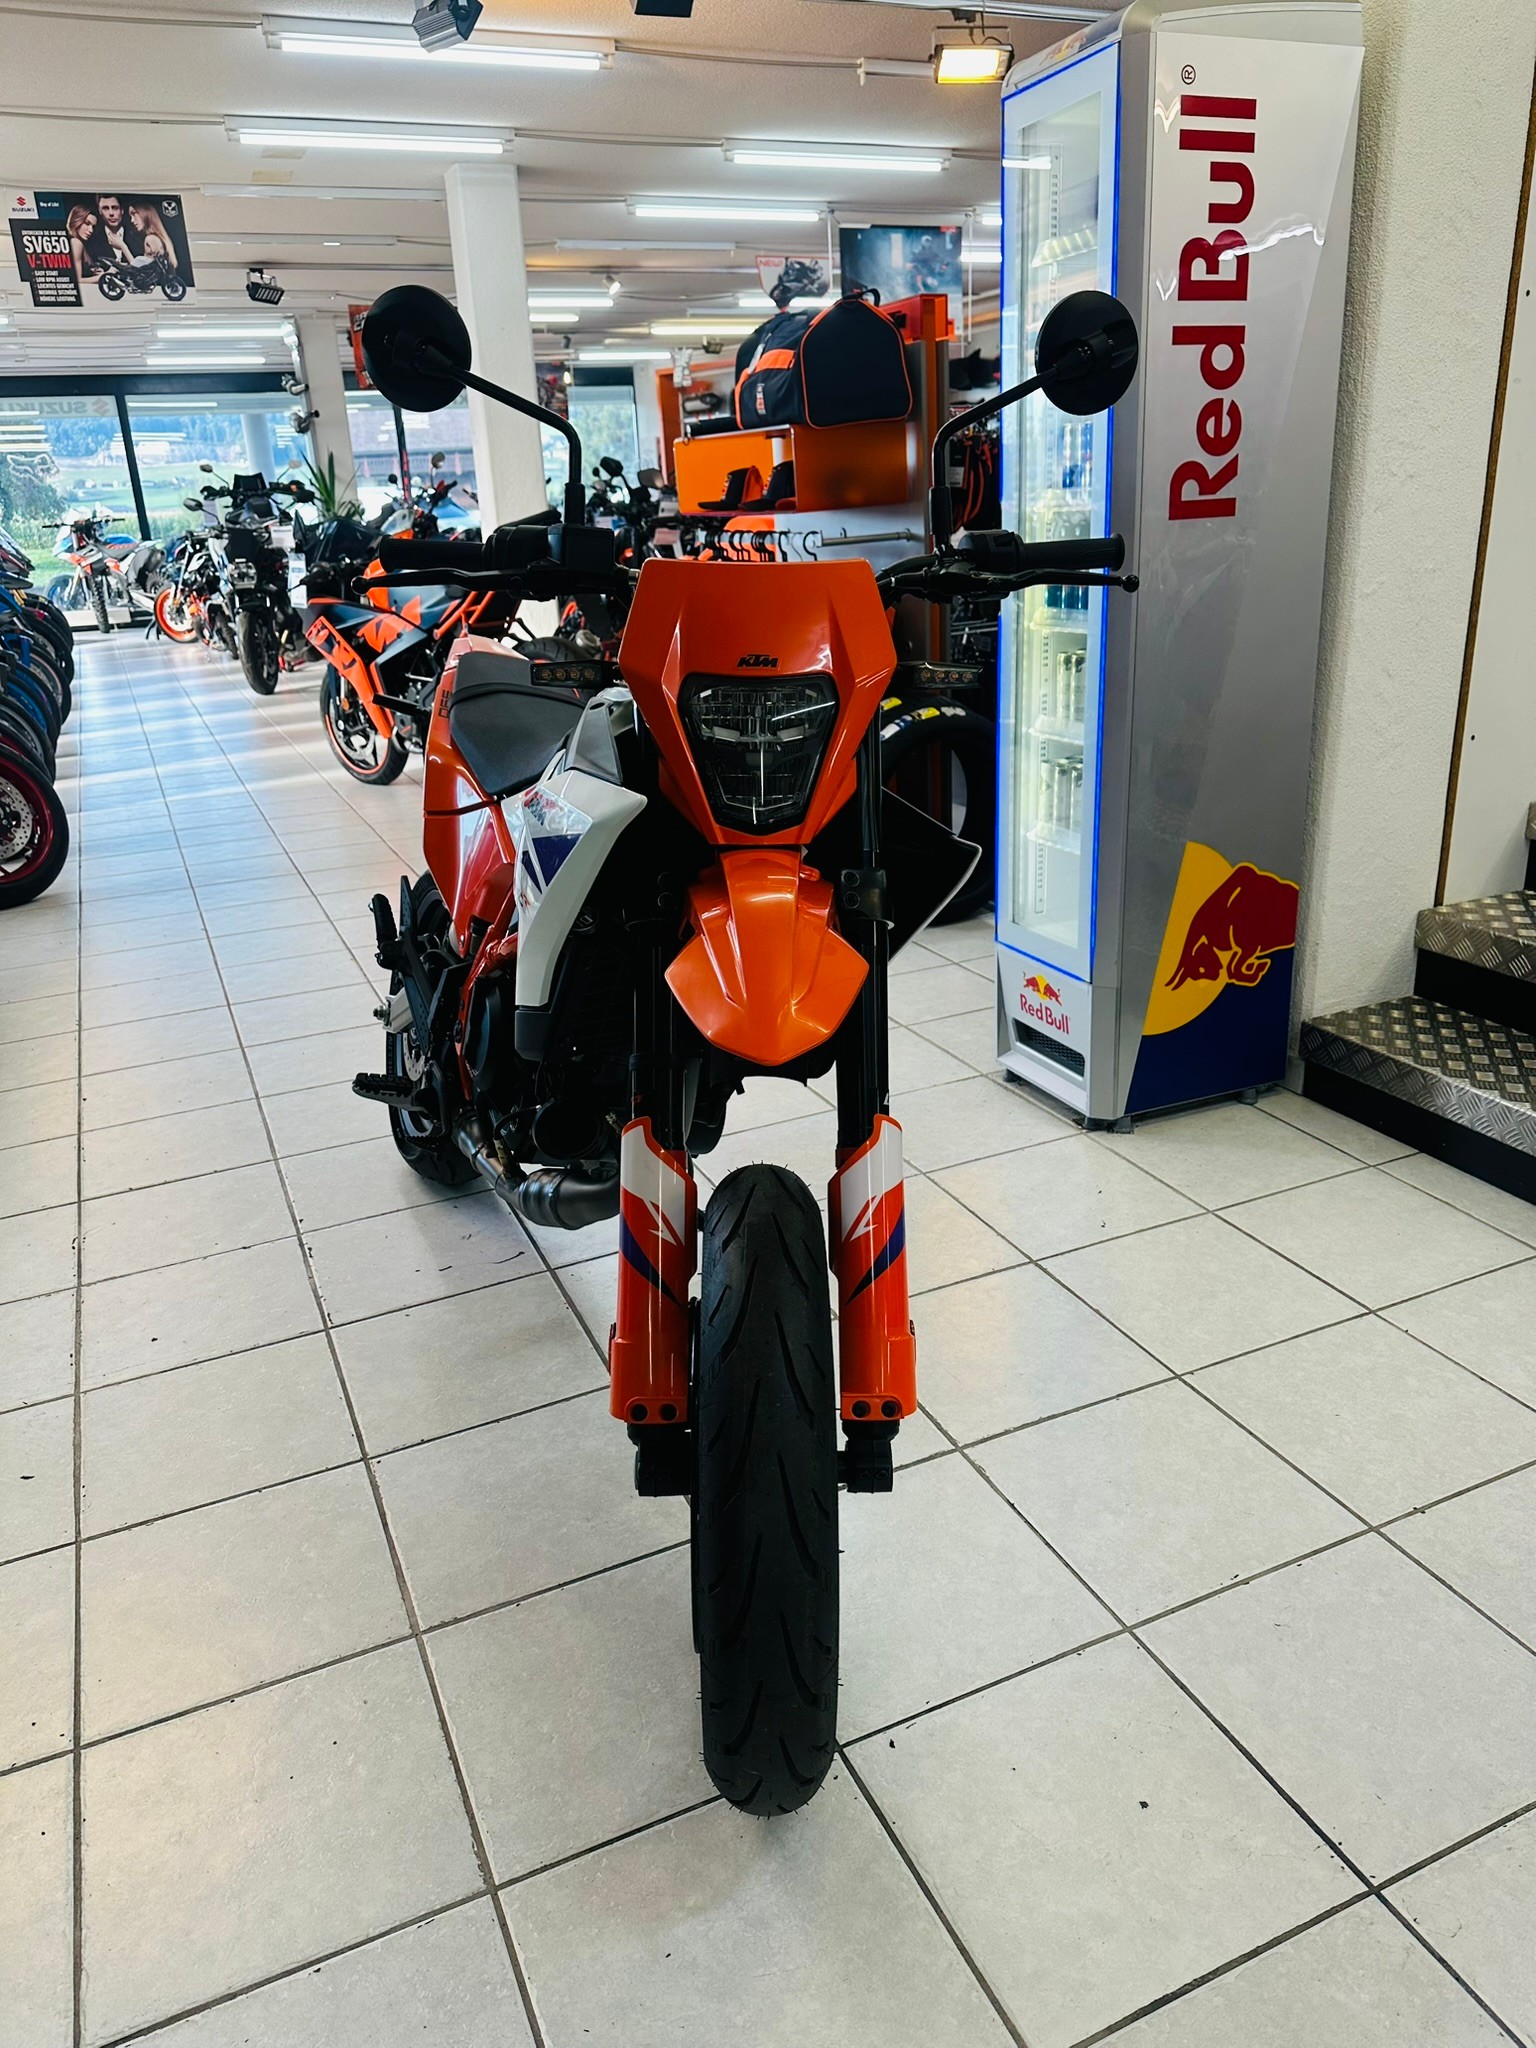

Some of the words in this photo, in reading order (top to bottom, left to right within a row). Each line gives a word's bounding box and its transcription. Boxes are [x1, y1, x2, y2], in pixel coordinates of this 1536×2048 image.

[23, 236, 70, 253] SV650
[28, 254, 72, 268] V-TWIN
[1168, 325, 1246, 520] Red
[737, 653, 779, 668] KTM
[1019, 993, 1044, 1021] Red
[1044, 1006, 1070, 1034] Bull
